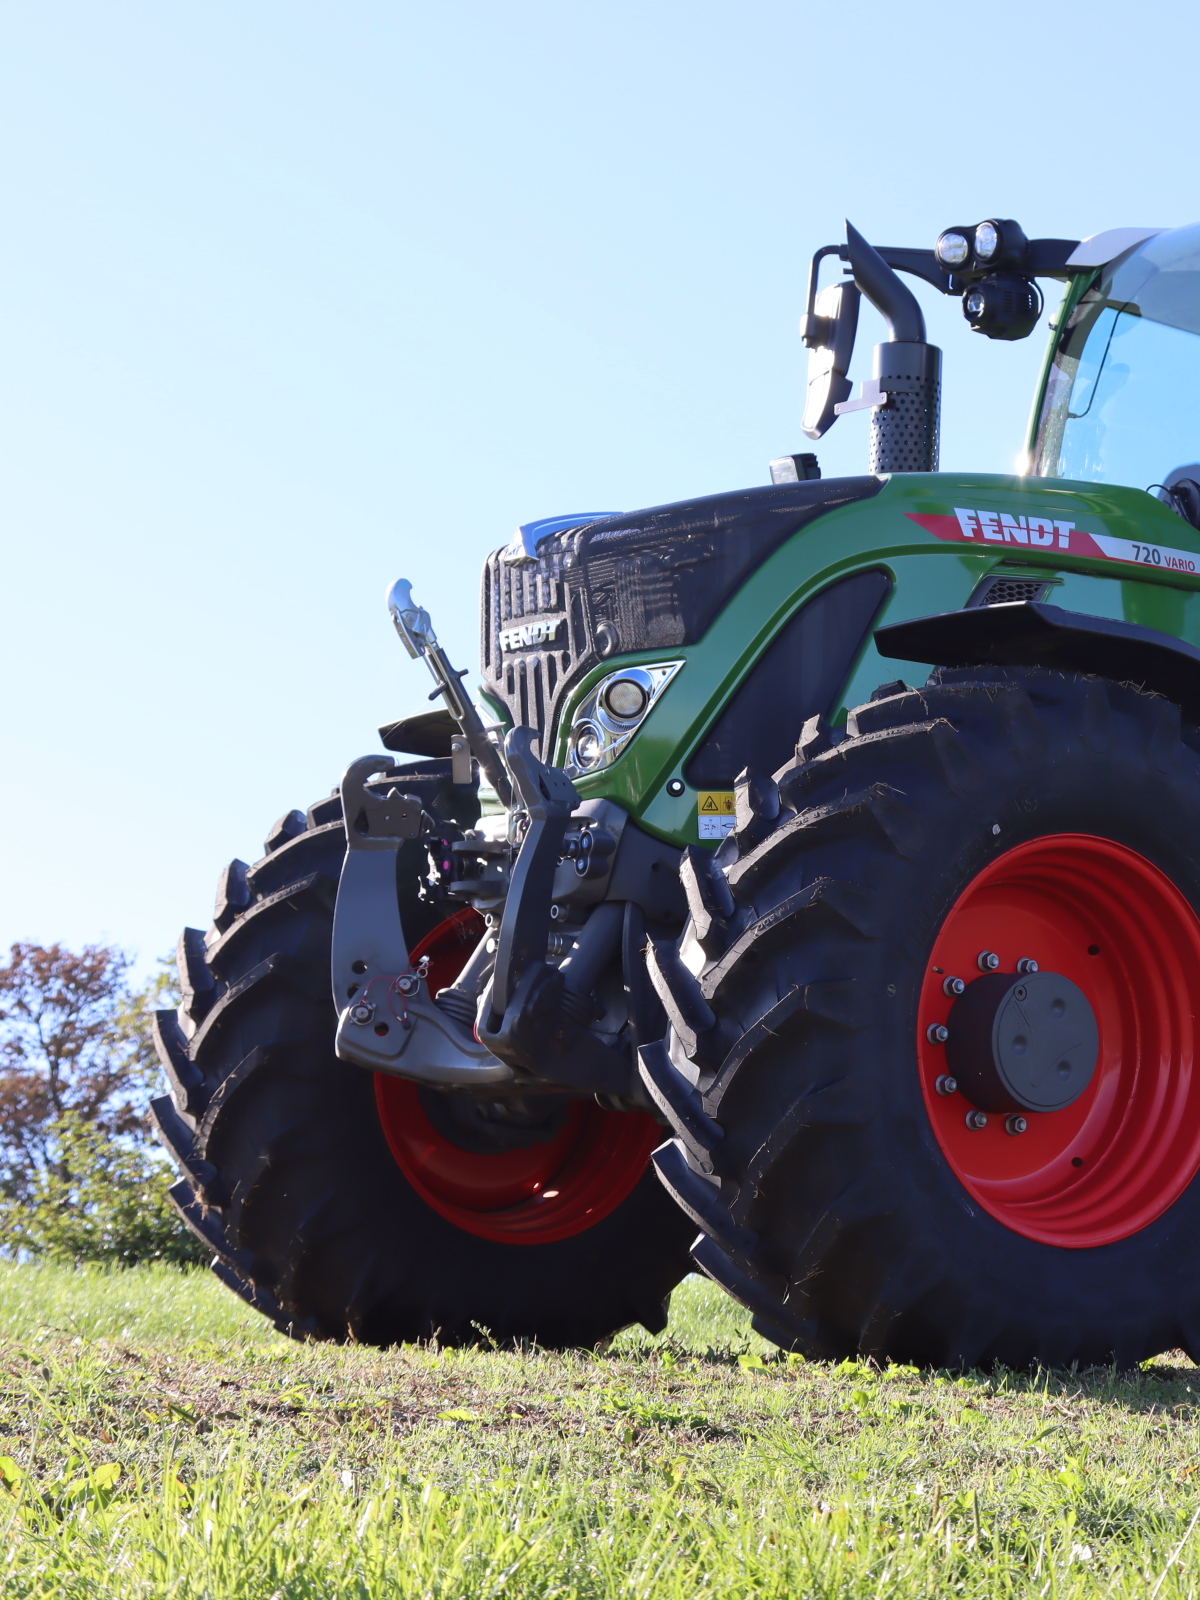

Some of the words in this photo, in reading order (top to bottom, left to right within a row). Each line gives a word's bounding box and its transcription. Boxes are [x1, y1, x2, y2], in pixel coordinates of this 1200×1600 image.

[953, 508, 1076, 549] FENDT
[1131, 545, 1161, 566] 720
[1164, 555, 1196, 572] VARIO
[499, 619, 562, 652] FENDT
